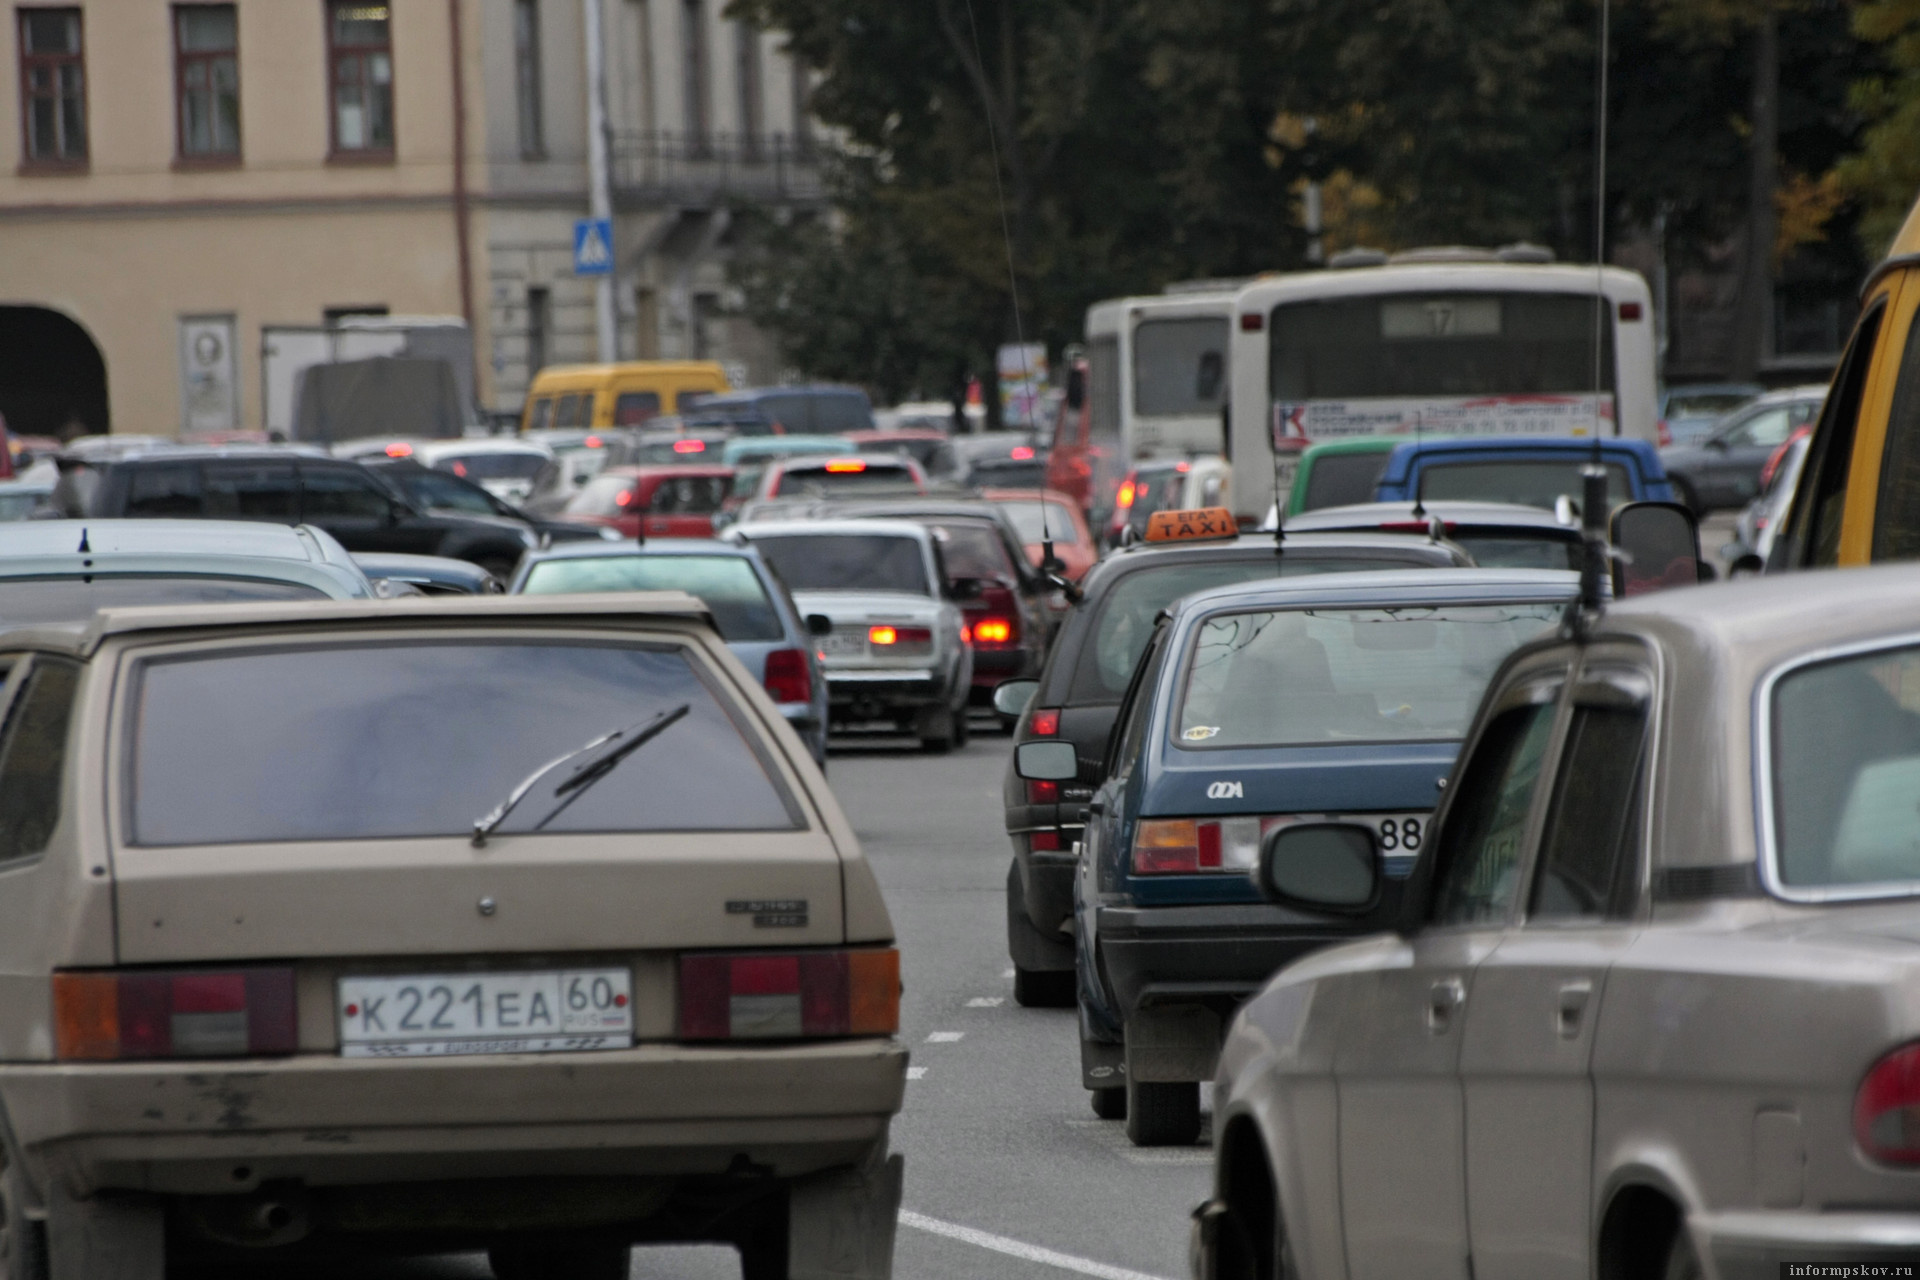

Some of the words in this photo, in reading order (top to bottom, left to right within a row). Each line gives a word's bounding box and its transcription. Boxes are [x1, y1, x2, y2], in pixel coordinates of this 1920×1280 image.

[1161, 520, 1228, 537] TAXI
[567, 977, 613, 1011] 60
[566, 1013, 598, 1026] RUS
